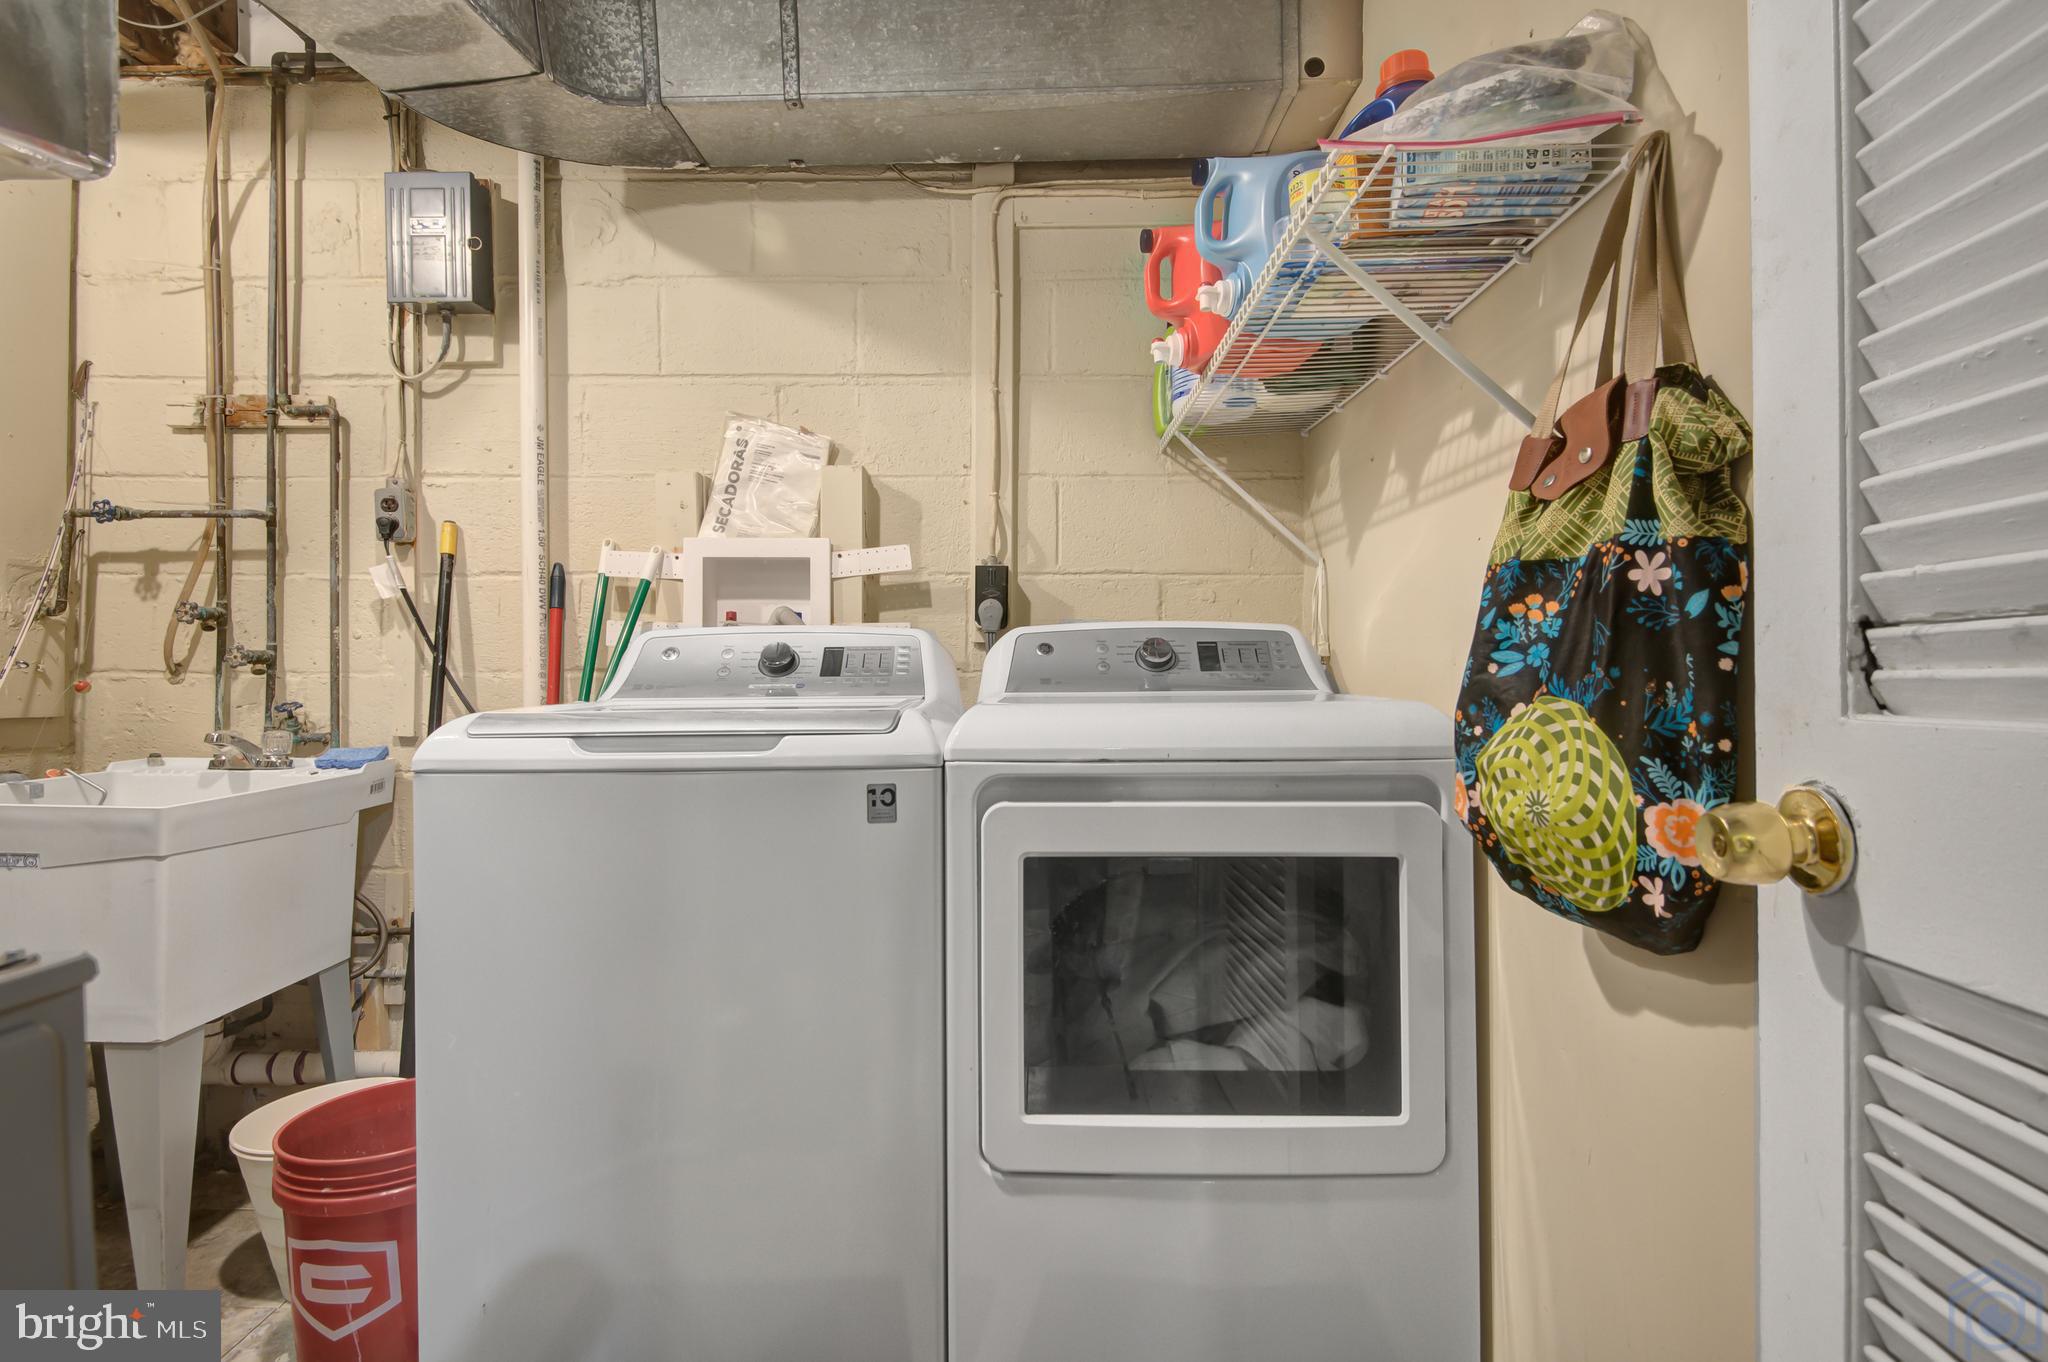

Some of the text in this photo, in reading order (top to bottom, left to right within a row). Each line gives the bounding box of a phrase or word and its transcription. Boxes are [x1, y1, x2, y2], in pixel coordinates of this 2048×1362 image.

[536, 452, 545, 486] EAGLE
[538, 554, 547, 585] SCH40
[538, 587, 547, 611] DWV
